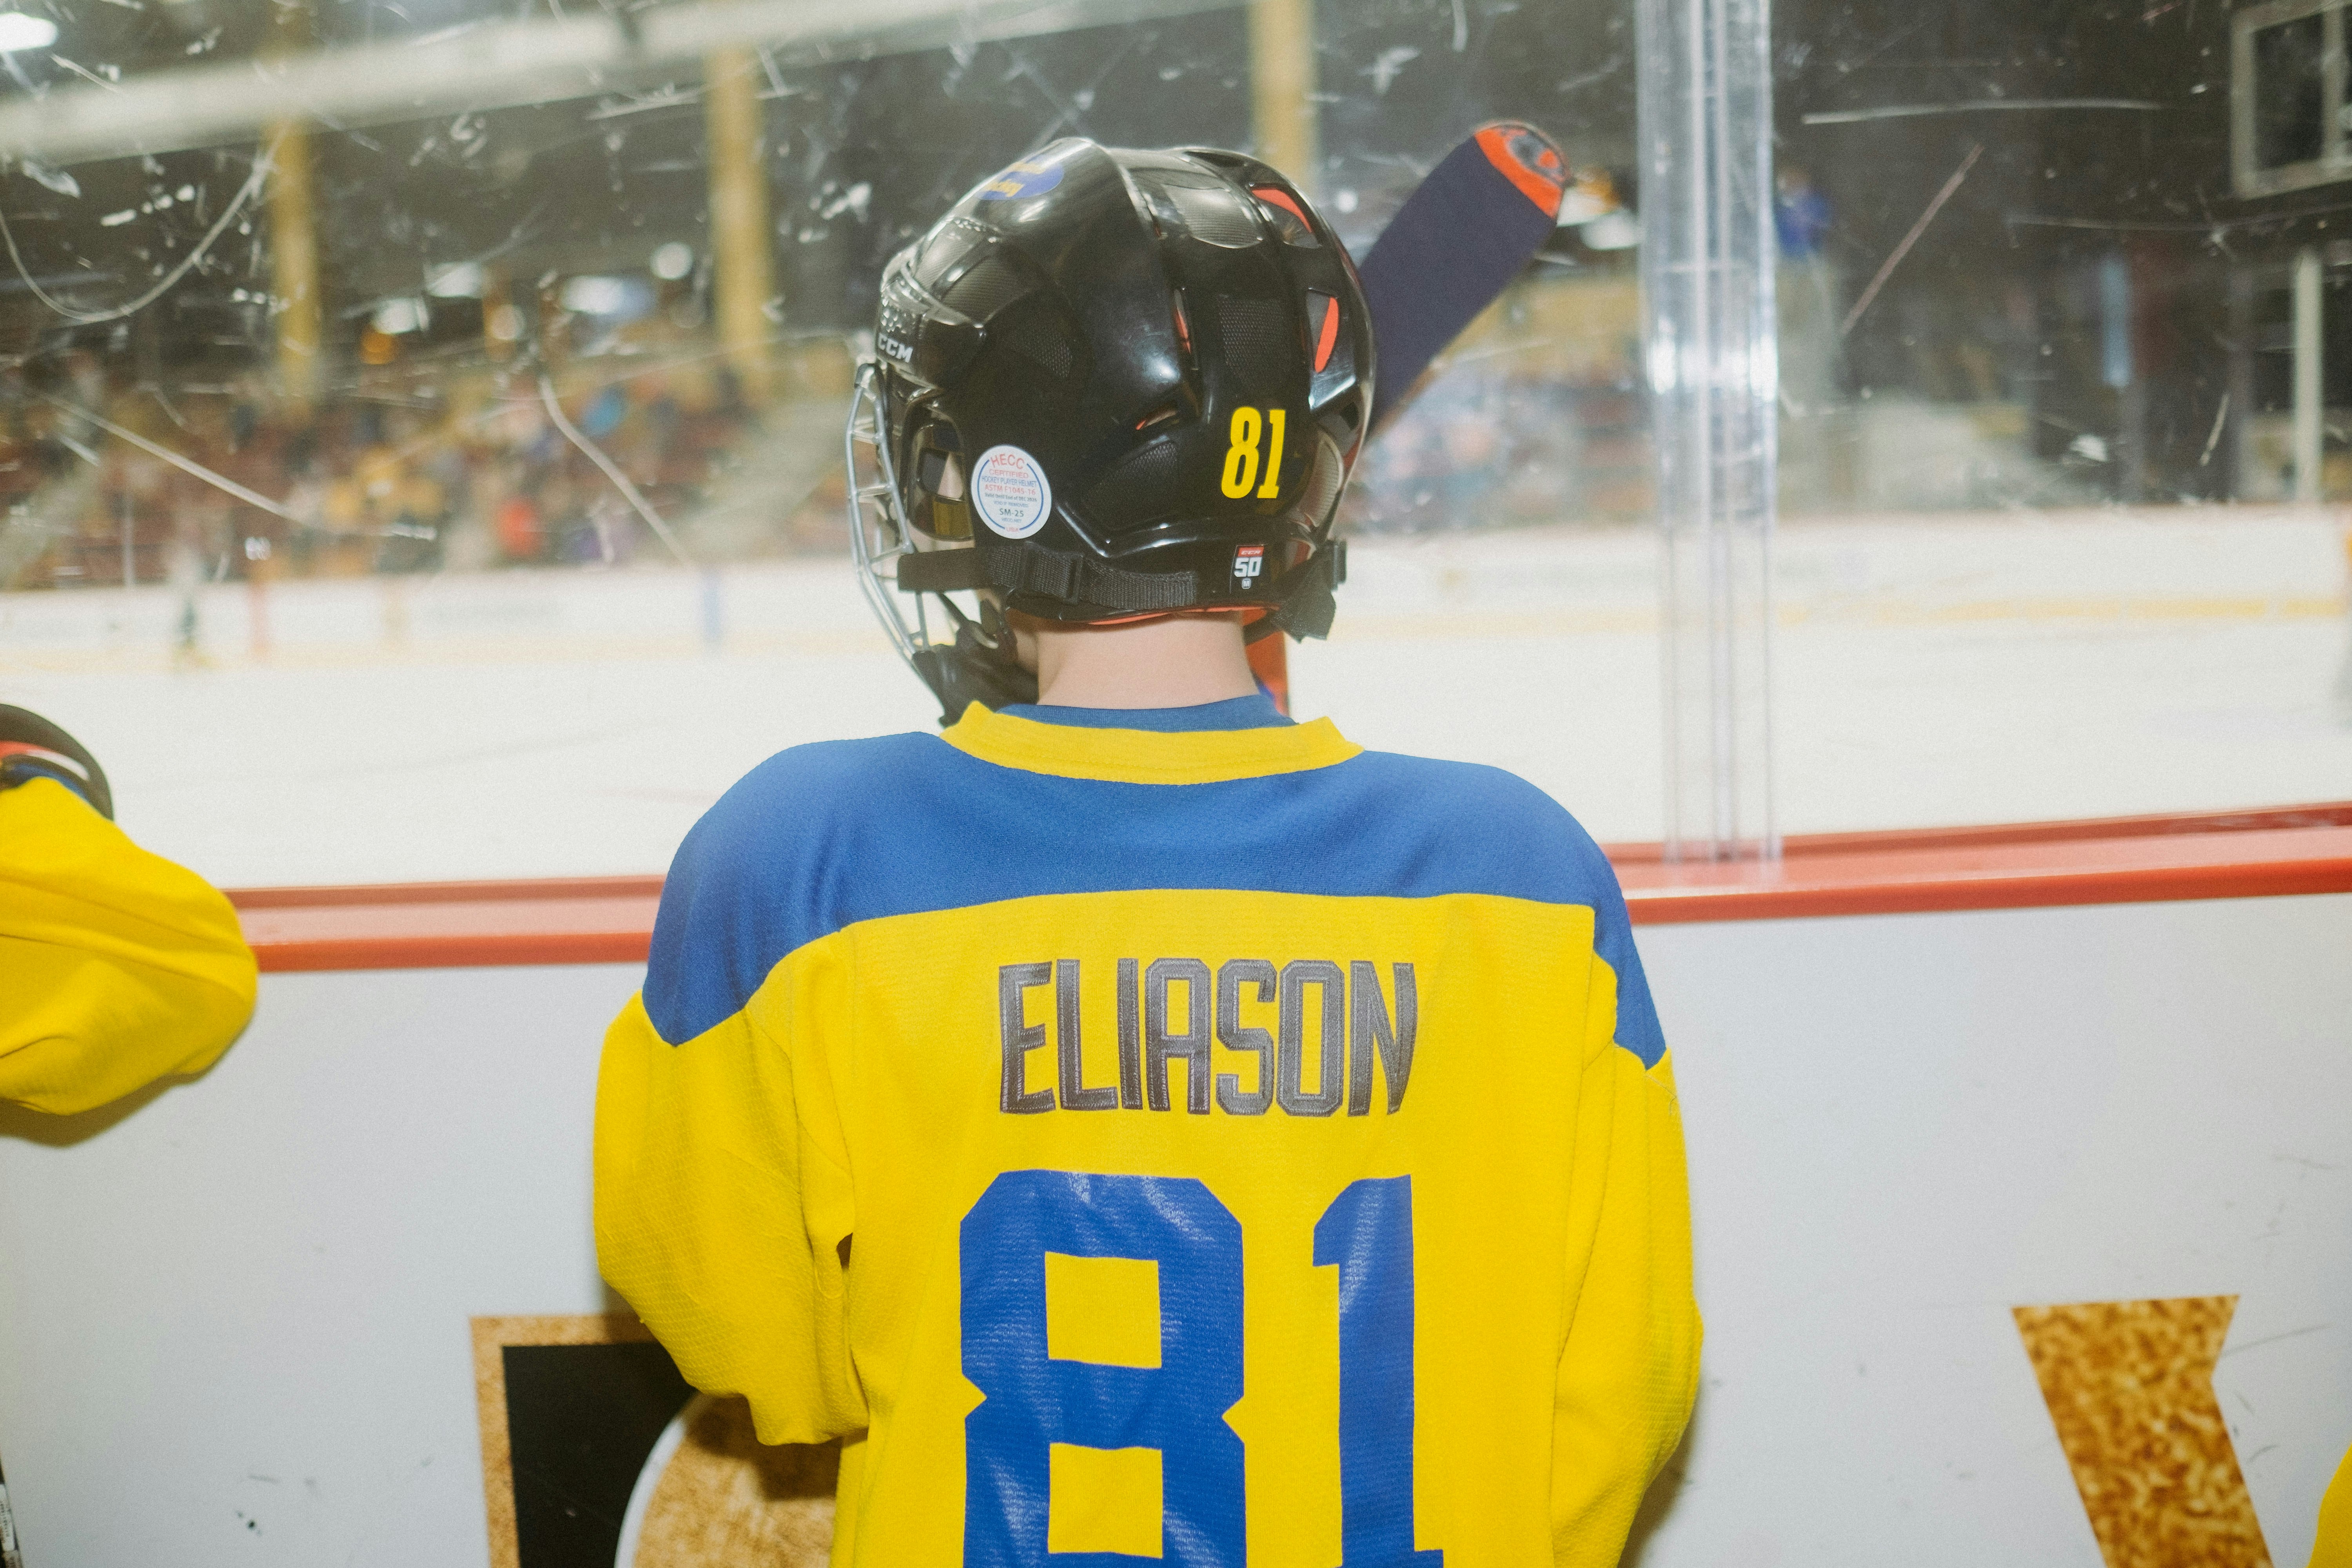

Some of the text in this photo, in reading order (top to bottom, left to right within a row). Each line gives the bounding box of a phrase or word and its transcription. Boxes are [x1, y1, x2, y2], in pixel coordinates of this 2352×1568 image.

[878, 332, 913, 363] CCM
[990, 453, 1025, 469] HECC
[1221, 407, 1286, 499] 81
[989, 469, 1029, 478] CERTIFIED
[1000, 508, 1024, 517] SM-25
[1234, 557, 1263, 577] 50
[998, 957, 1418, 1117] ELIASON
[959, 1169, 1445, 1568] 81
